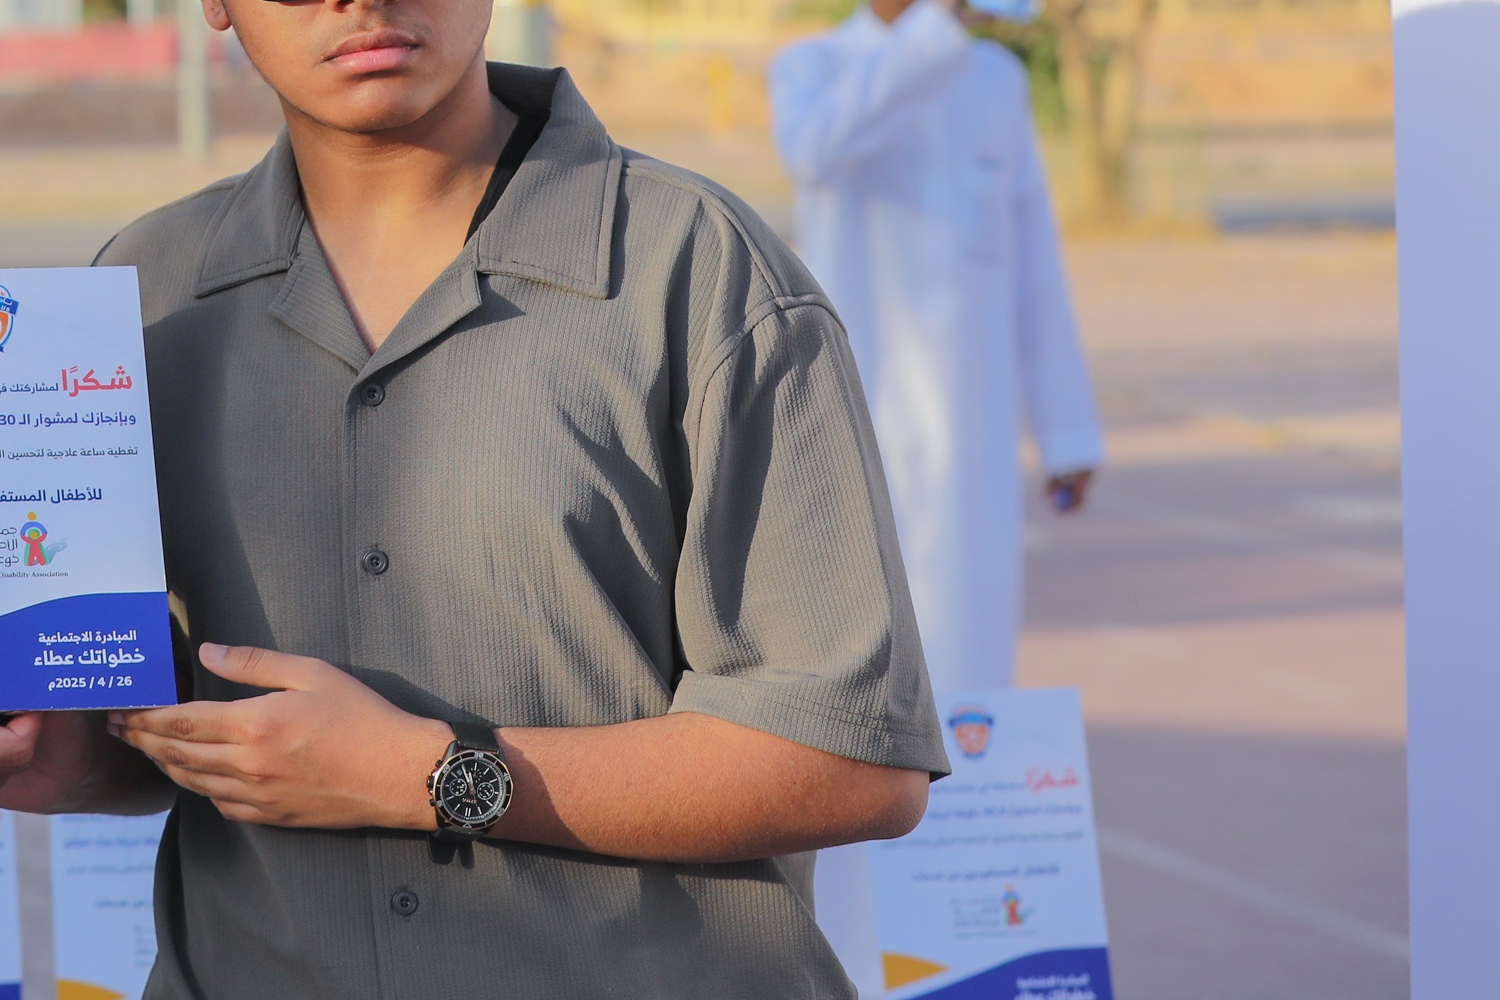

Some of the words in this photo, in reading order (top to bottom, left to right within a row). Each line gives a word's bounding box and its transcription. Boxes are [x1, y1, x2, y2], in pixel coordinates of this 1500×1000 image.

[61, 365, 132, 397] شكرًا
[9, 382, 59, 394] لمشاركتك
[0, 414, 16, 425] 30
[34, 412, 78, 428] لمشوار
[82, 411, 137, 426] وبإنجازك
[7, 448, 44, 460] لتحسين
[47, 448, 78, 459] علاجية
[80, 447, 105, 456] ساعة
[107, 446, 138, 458] تغطية
[50, 487, 102, 504] للأطفال
[38, 631, 93, 646] الاجتماعية
[95, 629, 137, 644] المبادرة
[34, 649, 75, 666] عطاء
[78, 647, 146, 668] خطواتك
[97, 676, 106, 687] 4
[116, 675, 133, 687] 26
